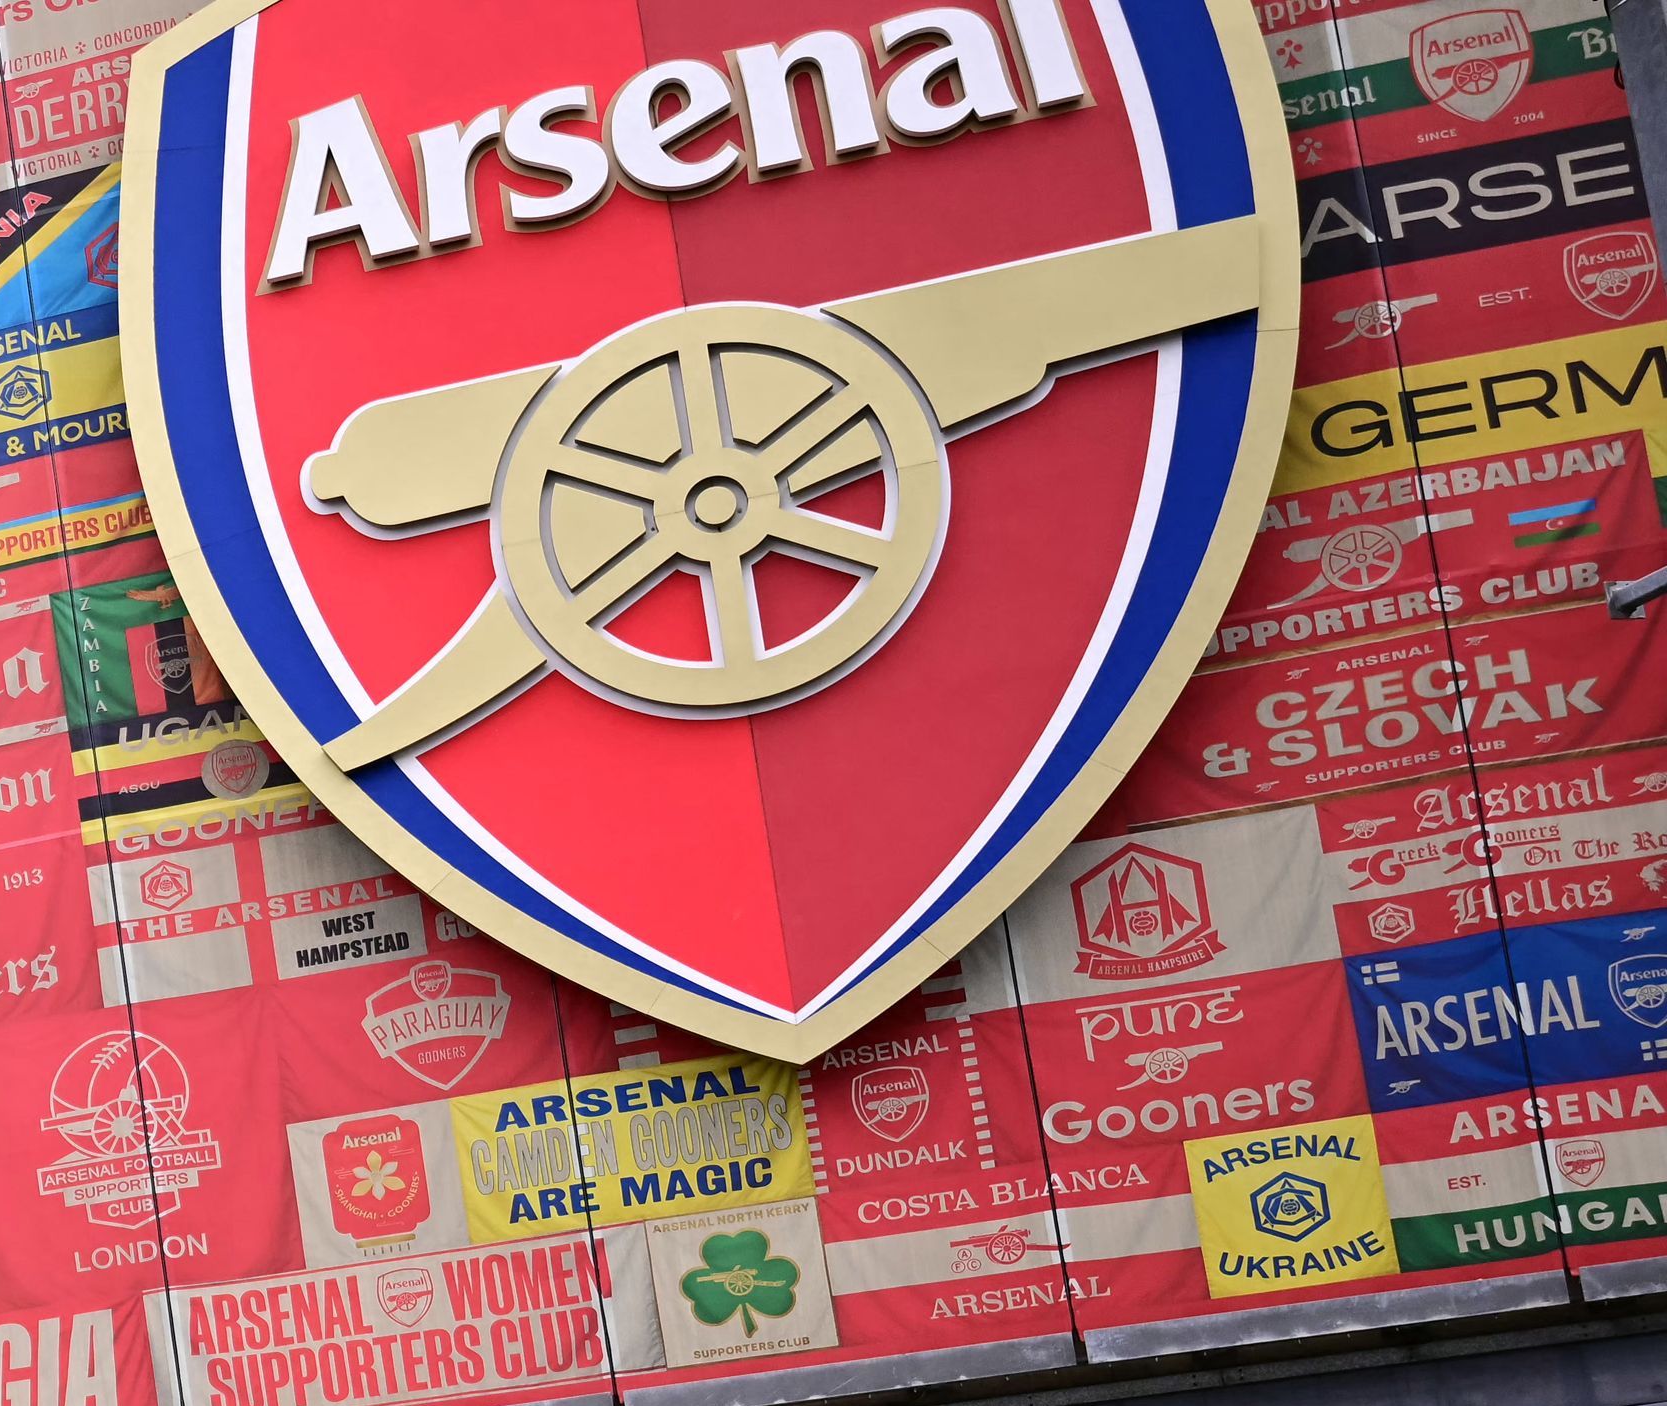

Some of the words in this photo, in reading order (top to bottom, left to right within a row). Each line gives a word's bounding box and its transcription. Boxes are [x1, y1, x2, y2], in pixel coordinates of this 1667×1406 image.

[256, 0, 1095, 296] Arsenal
[1417, 129, 1457, 143] SINCE
[1513, 111, 1544, 124] 2004
[1336, 644, 1434, 672] ARSENAL
[1255, 649, 1532, 728] CZECH
[1267, 678, 1603, 767] SLOVAK
[125, 912, 194, 941] THE
[214, 878, 394, 927] ARSENAL
[321, 911, 376, 938] WEST
[296, 931, 410, 969] HAMPSTEAD
[372, 999, 504, 1048] PARAGUAY
[417, 1045, 466, 1065] GOONERS
[1202, 1134, 1361, 1183] ARSENAL
[858, 1190, 979, 1224] COSTA
[990, 1163, 1149, 1205] BLANCA
[1219, 1230, 1386, 1279] UKRAINE
[189, 1276, 373, 1356] ARSENAL
[441, 1238, 613, 1322] WOMEN
[930, 1276, 1111, 1321] ARSENAL
[491, 1306, 604, 1381] CLUB
